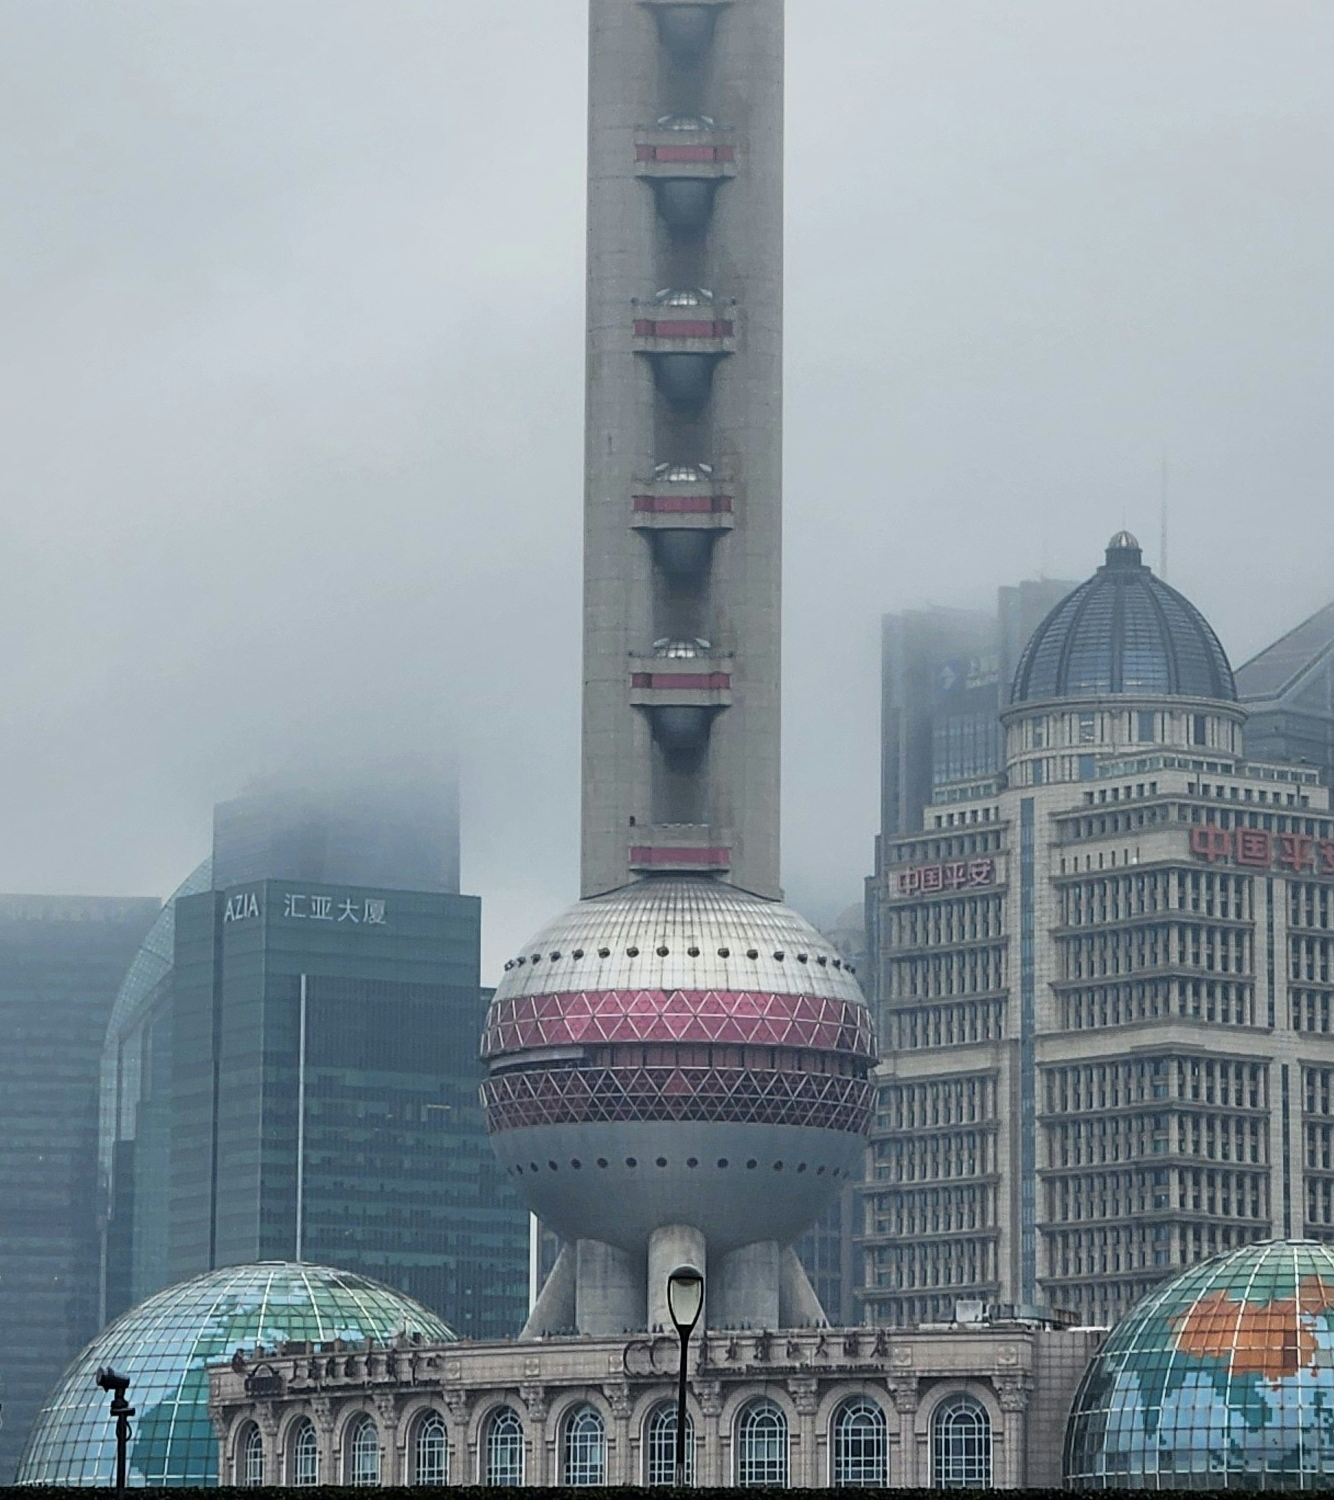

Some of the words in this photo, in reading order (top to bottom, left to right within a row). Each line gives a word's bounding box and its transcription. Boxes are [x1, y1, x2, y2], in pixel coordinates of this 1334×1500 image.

[896, 858, 992, 895] 中国平安
[224, 892, 260, 923] AZIA
[283, 893, 387, 925] 汇亚大厦
